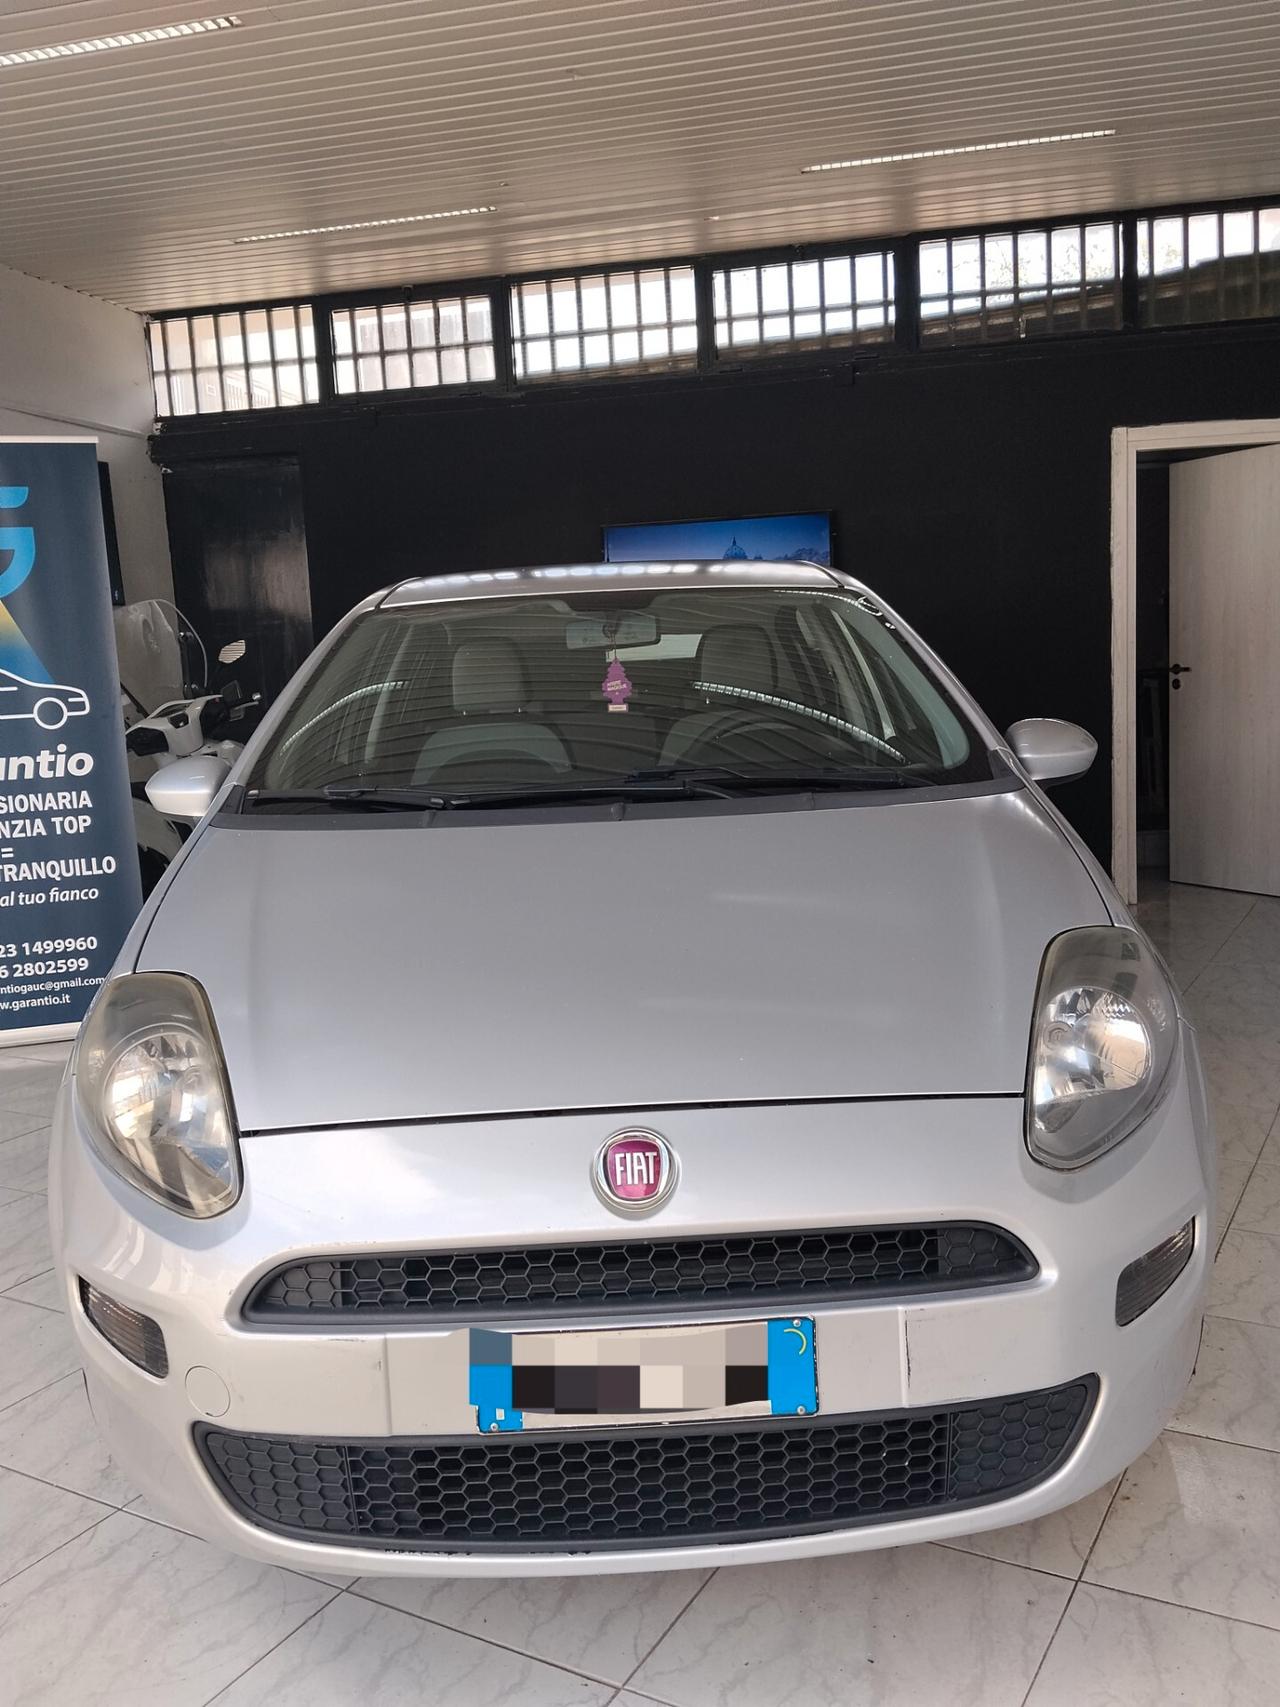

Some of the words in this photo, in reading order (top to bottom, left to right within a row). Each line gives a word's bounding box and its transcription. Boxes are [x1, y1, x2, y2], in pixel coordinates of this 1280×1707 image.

[0, 744, 94, 780] ntio
[0, 790, 93, 814] SIONARIA
[0, 818, 47, 839] NZIA
[51, 815, 91, 835] TOP
[0, 856, 116, 882] RANQUILLO
[0, 890, 15, 907] al
[18, 891, 46, 906] tuo
[49, 886, 99, 903] fianco
[22, 936, 98, 956] 1499960
[0, 964, 9, 979] 6
[12, 957, 89, 977] 2802599
[614, 1151, 658, 1186] FIAT
